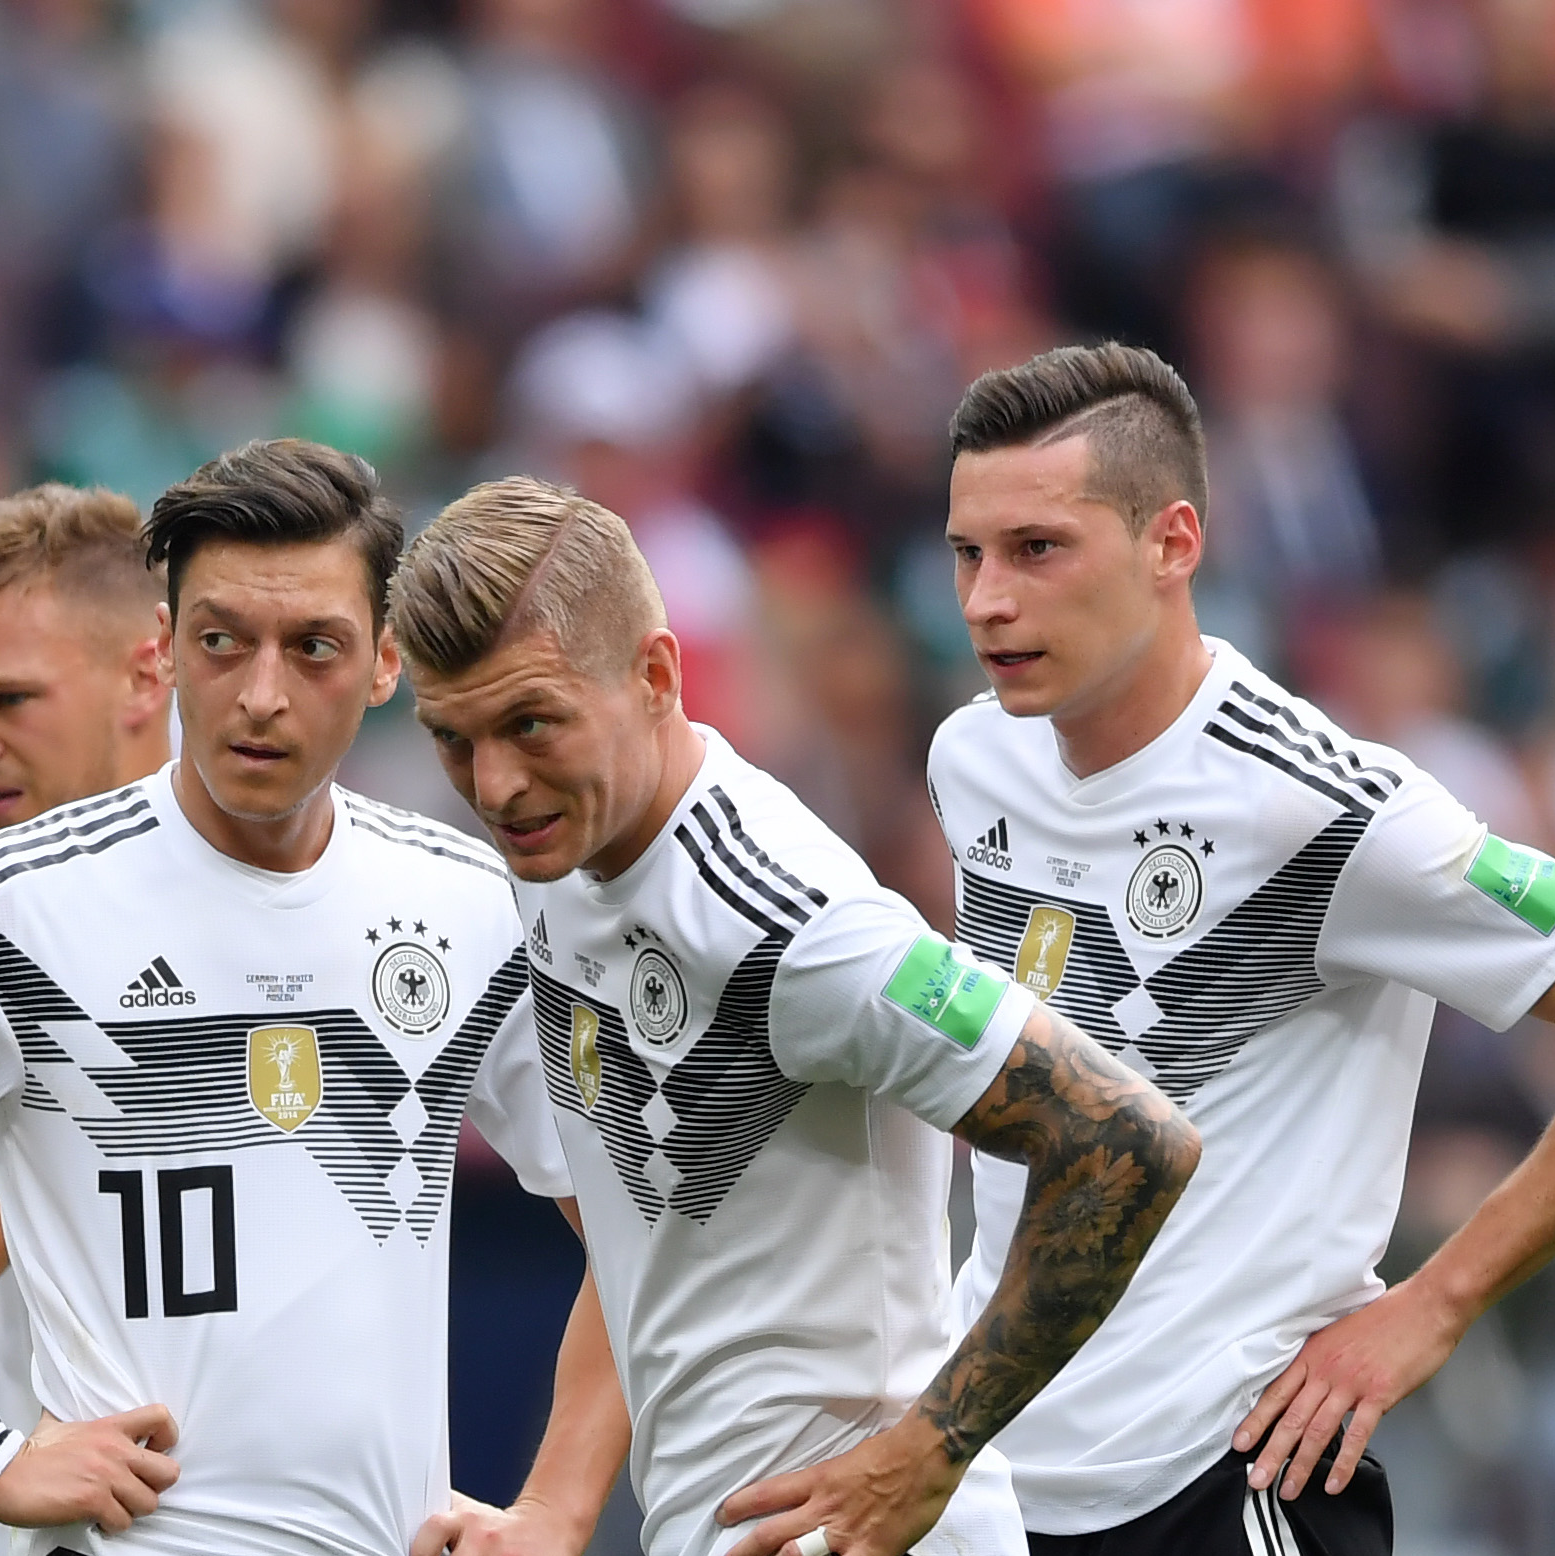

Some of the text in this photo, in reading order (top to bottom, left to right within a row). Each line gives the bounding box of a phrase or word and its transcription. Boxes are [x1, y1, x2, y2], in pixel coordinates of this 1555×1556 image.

[967, 845, 1012, 871] adidas
[1148, 857, 1188, 876] DEUTSCHER
[389, 954, 433, 972] DEUTSCHER
[286, 974, 313, 983] MEXICO
[962, 972, 981, 993] FIFA
[1027, 970, 1049, 987] FIFA
[120, 988, 197, 1008] adidas
[386, 996, 439, 1023] FUSSBALL-BUND
[271, 1092, 304, 1106] FIFA
[278, 1111, 298, 1119] 2014
[99, 1165, 237, 1319] 10
